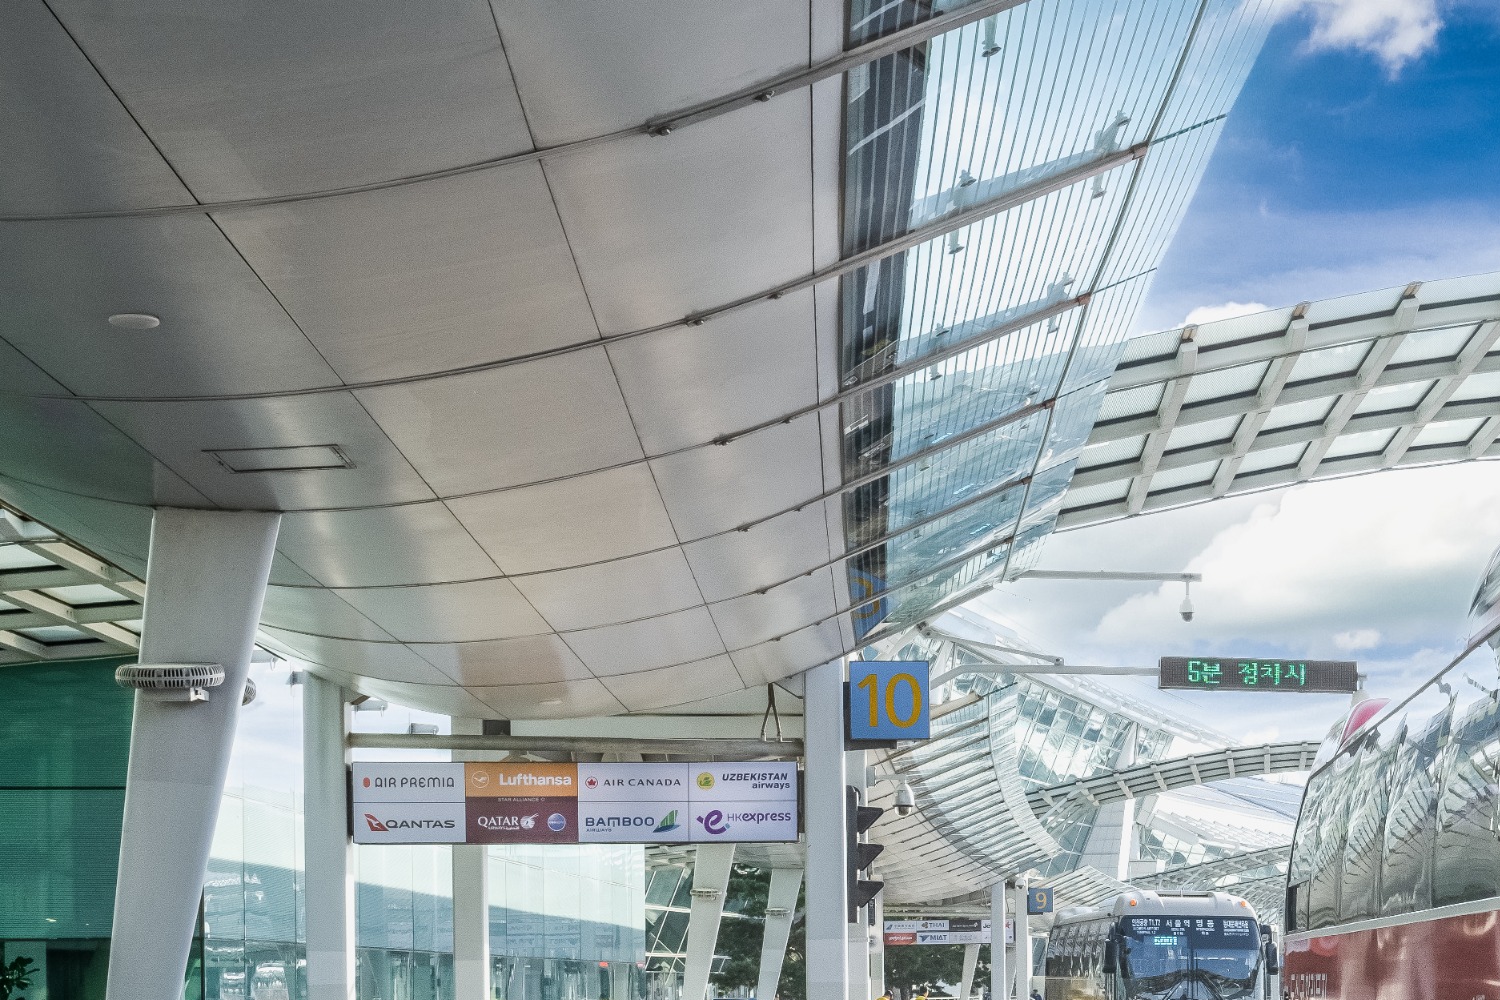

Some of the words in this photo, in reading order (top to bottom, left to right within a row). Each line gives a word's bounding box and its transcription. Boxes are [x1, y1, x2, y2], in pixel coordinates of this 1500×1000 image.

[1188, 660, 1223, 684] 5분
[857, 672, 922, 728] 10
[374, 777, 397, 788] AIR
[401, 777, 455, 788] PREMIA
[499, 773, 572, 786] Lufthansa
[604, 778, 625, 787] AIR
[628, 778, 681, 787] CANADA
[722, 772, 788, 781] UZBEKISTAN
[752, 781, 791, 790] airways
[385, 819, 456, 829] QANTAS
[477, 816, 519, 828] QATAR
[585, 816, 655, 828] BAMBOO
[1035, 891, 1047, 909] 9
